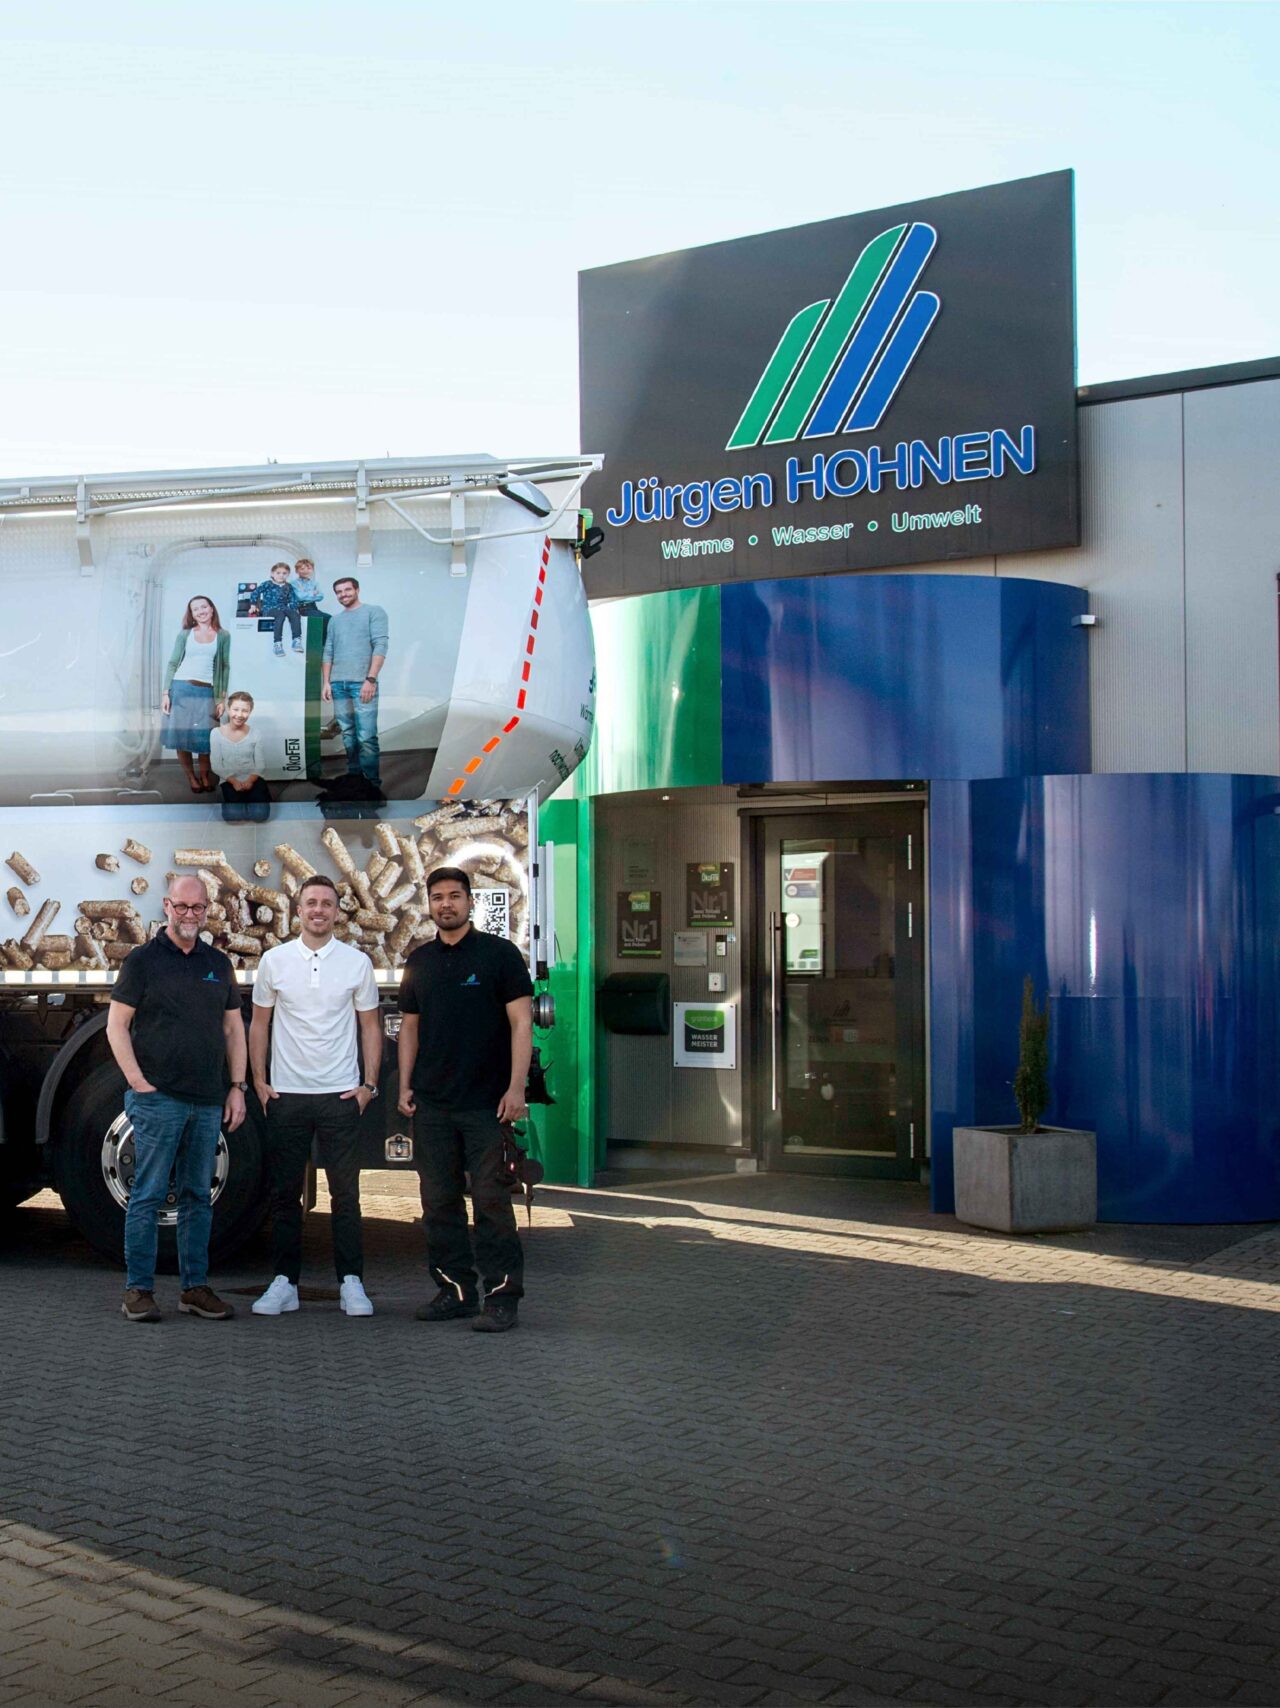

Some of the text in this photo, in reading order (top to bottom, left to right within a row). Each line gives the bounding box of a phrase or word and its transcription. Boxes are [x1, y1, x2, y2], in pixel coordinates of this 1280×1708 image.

[606, 425, 1036, 527] Jürgen HOHNEN
[661, 504, 983, 560] Wärme Wasser Umwelt
[691, 1033, 719, 1041] WASSER
